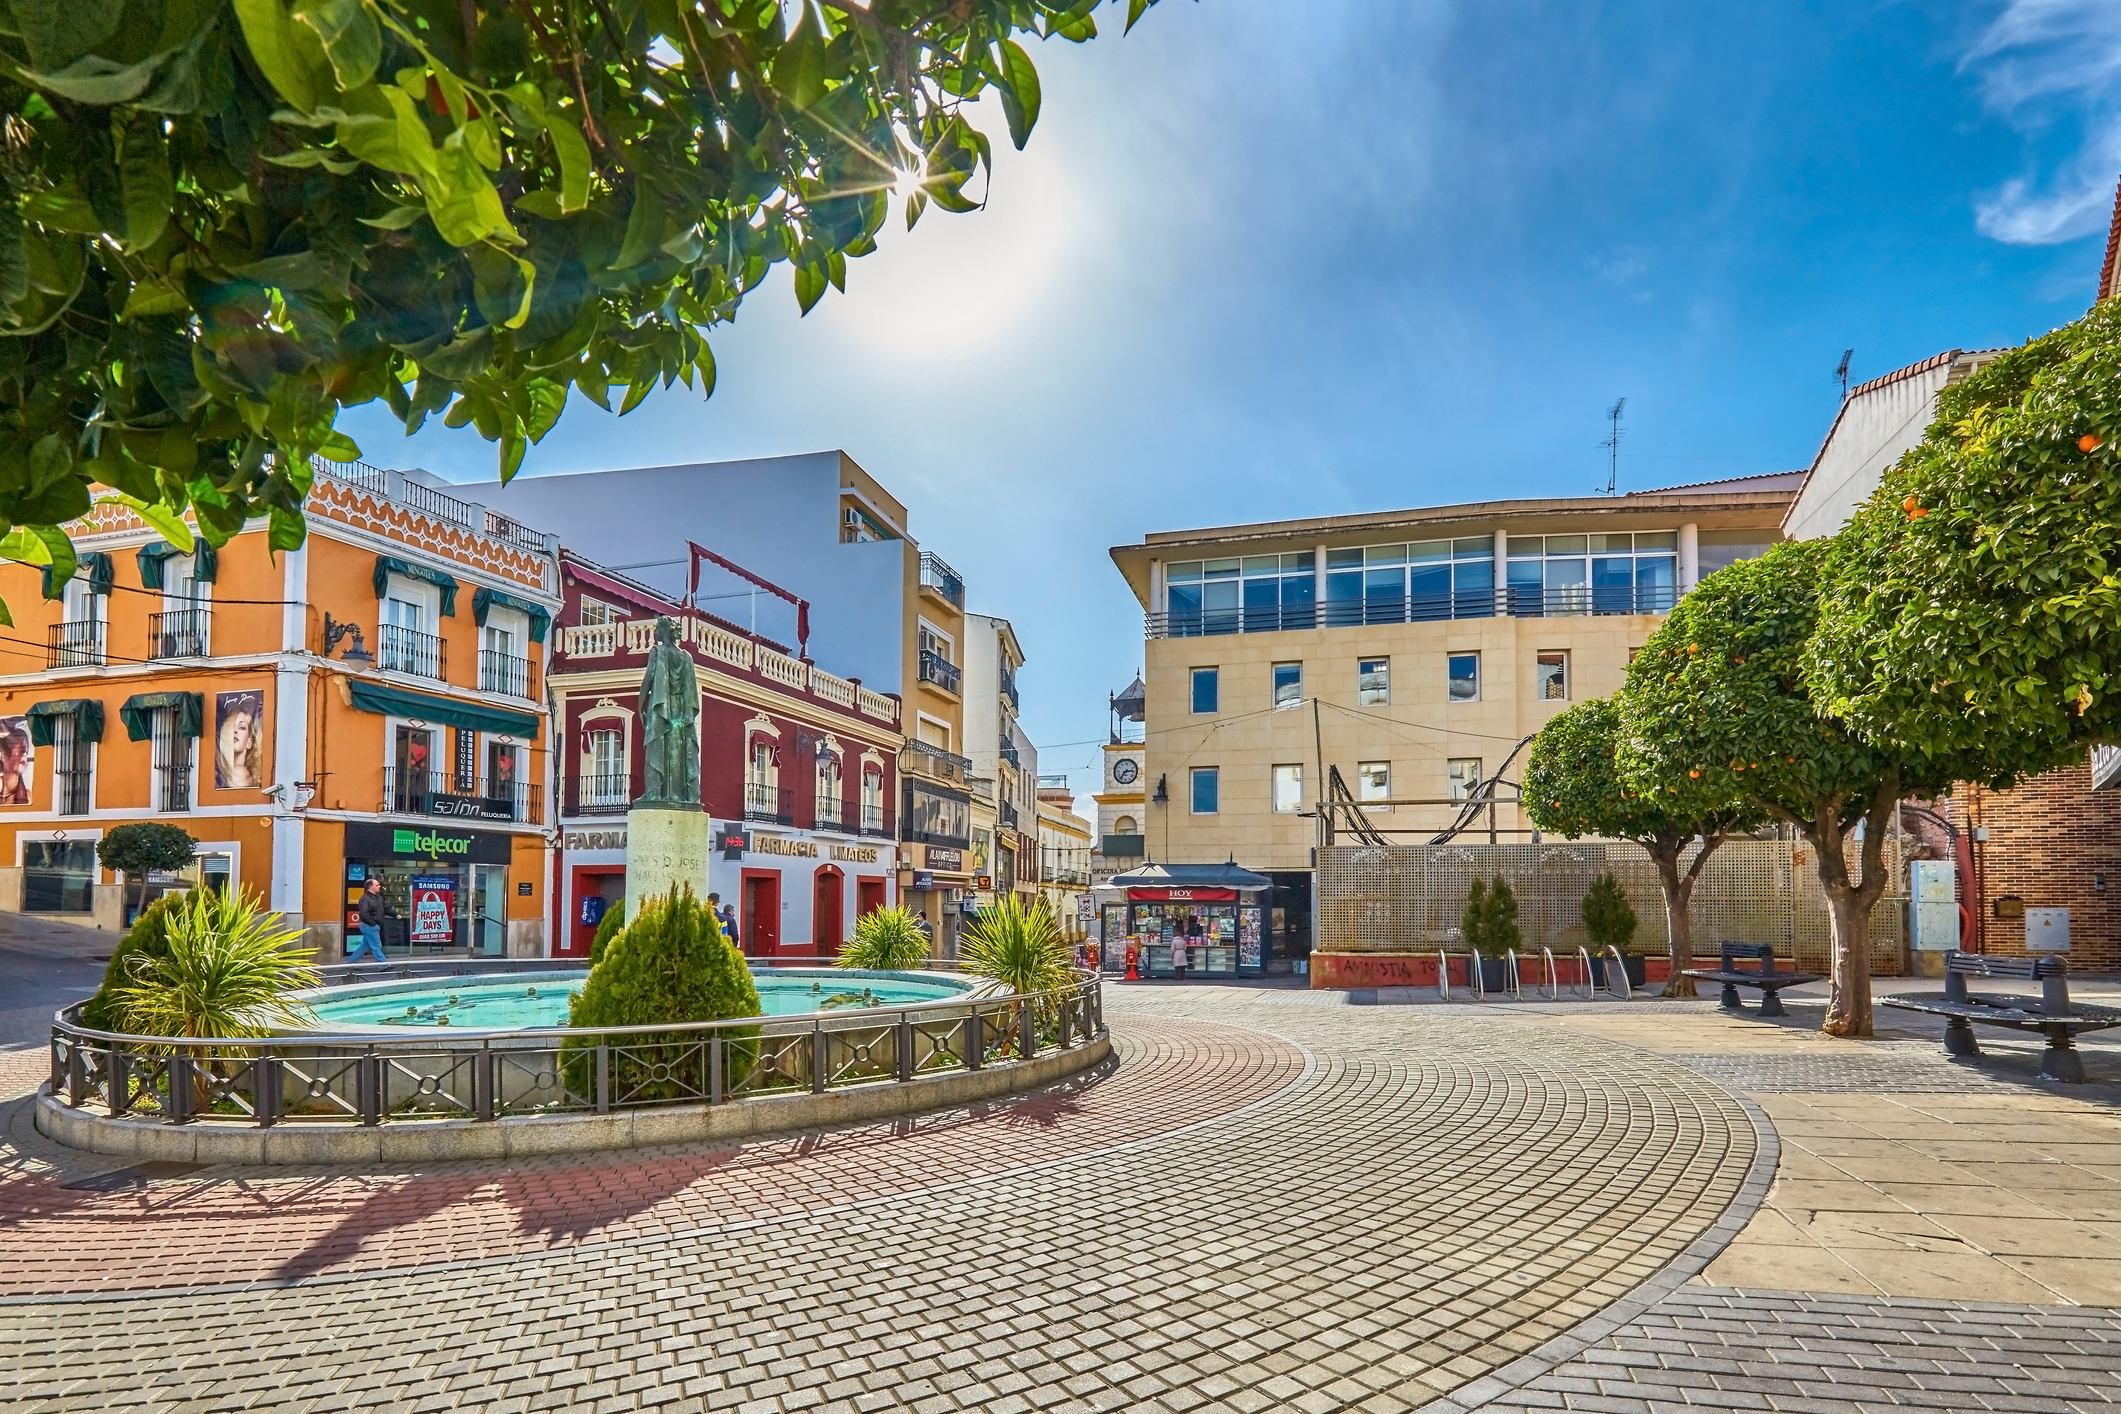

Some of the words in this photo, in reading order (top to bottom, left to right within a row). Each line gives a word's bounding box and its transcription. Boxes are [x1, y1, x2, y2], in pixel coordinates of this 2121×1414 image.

[414, 829, 471, 860] telecor
[725, 836, 744, 847] 14:36
[753, 837, 819, 858] FARMACIA
[837, 846, 877, 863] MATEOS
[418, 882, 450, 890] SAMSUNG
[1169, 889, 1193, 898] HOY
